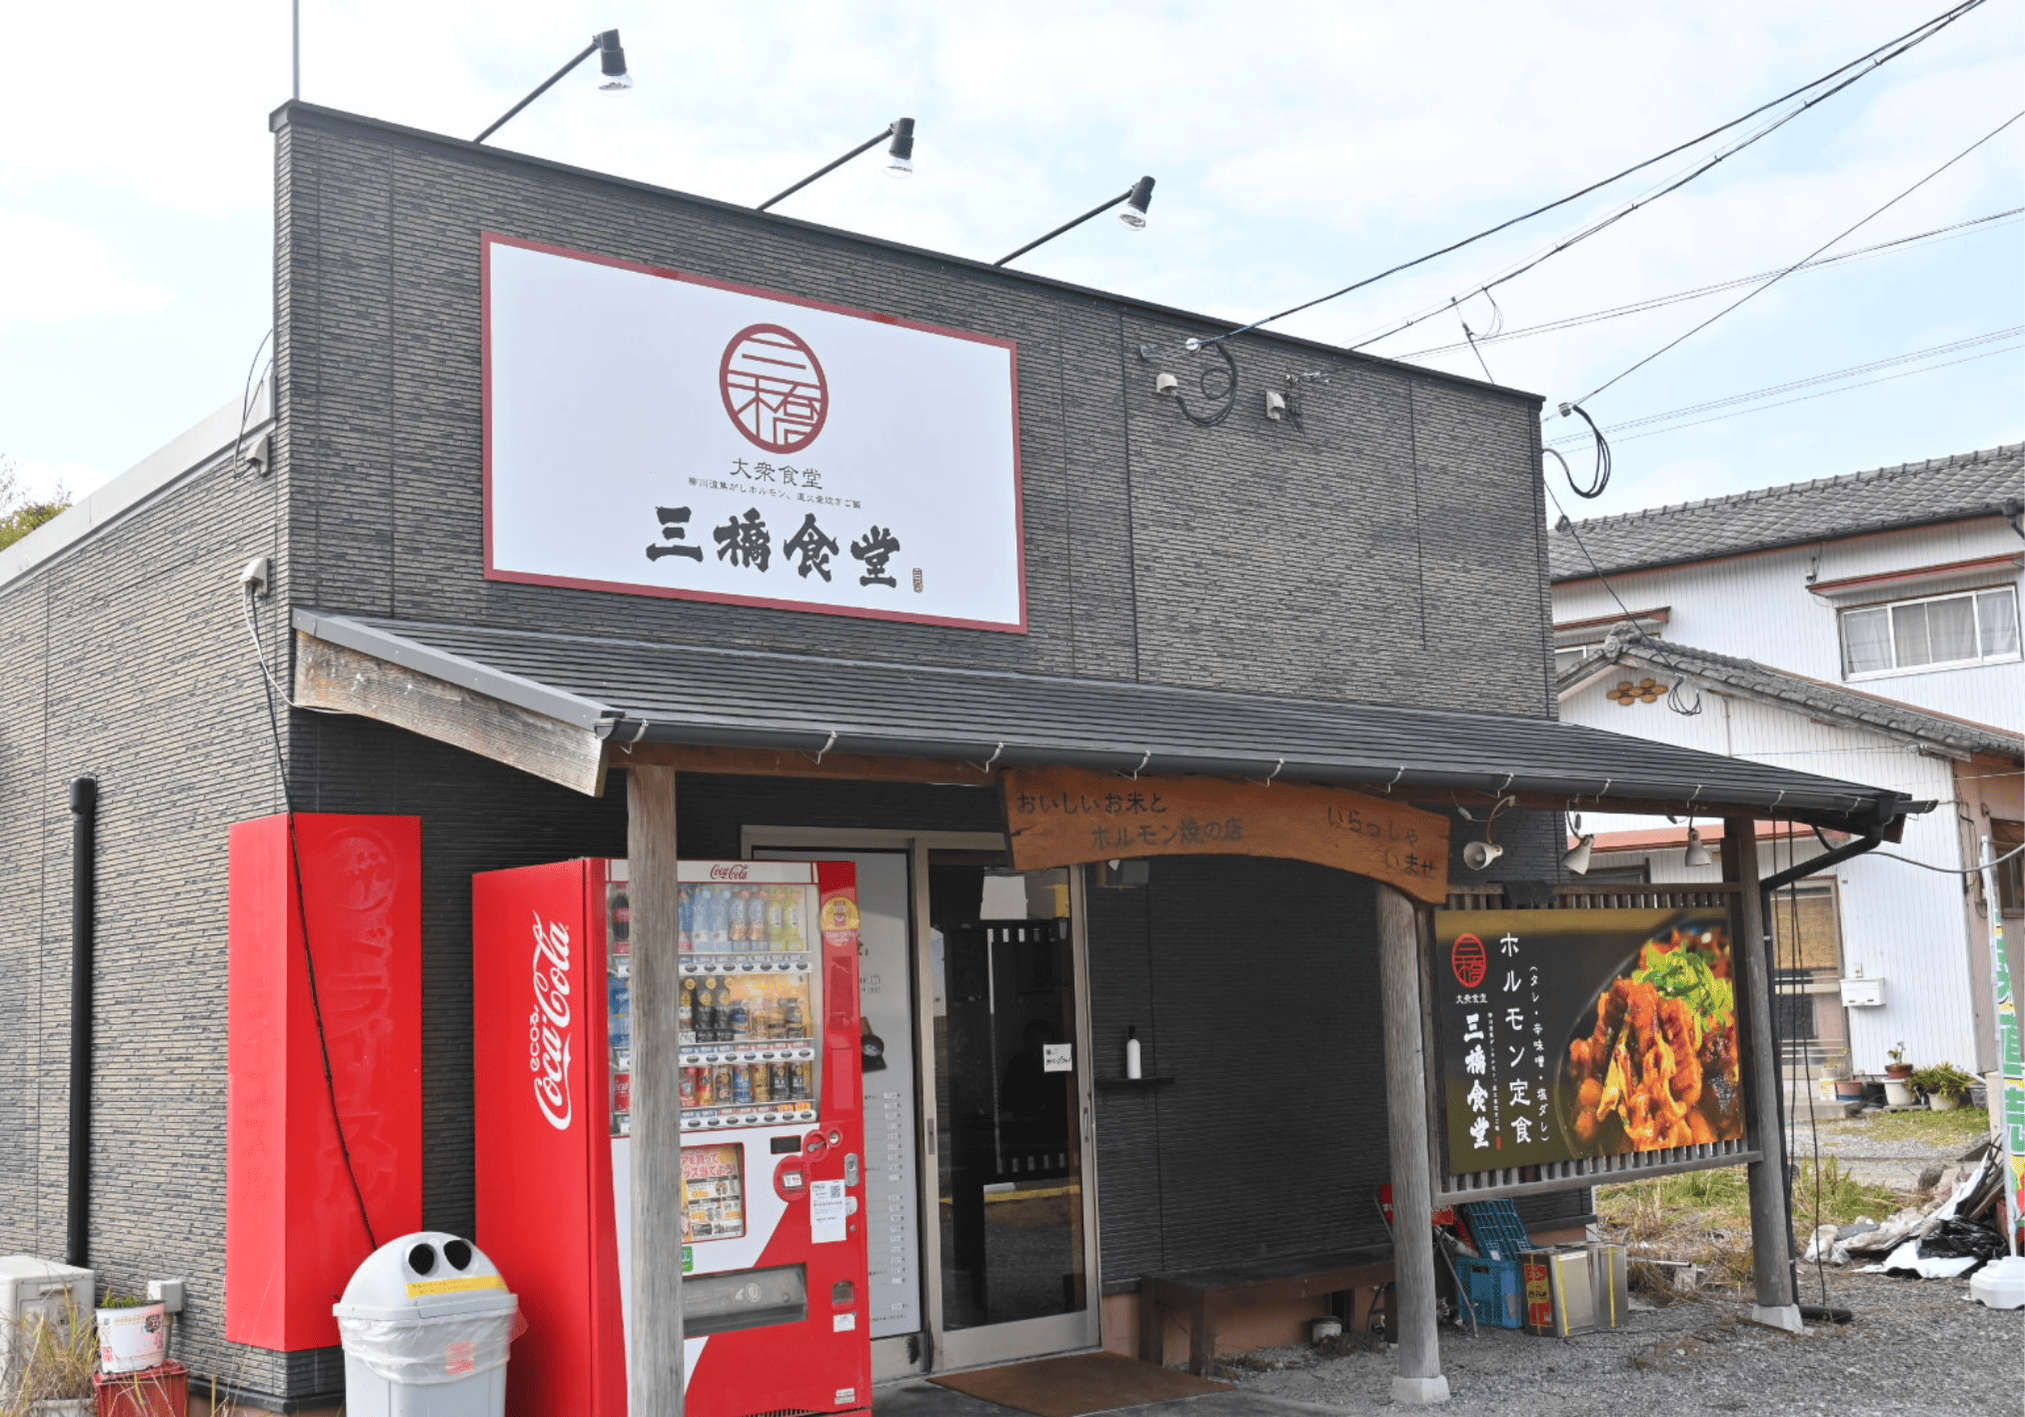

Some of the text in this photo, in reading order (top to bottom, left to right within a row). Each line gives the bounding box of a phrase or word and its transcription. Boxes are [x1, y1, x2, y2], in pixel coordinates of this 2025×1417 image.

[730, 457, 823, 490] 大衆食堂
[645, 505, 901, 589] 三橋食堂
[1016, 792, 1168, 815] おいしいお米と
[1091, 816, 1244, 851] ホルモン焼の店
[710, 863, 748, 880] Coca-Cola
[533, 910, 571, 1131] Coca-Cola
[1500, 932, 1533, 1144] ホルモン定食
[1463, 1012, 1490, 1149] 三橋食堂
